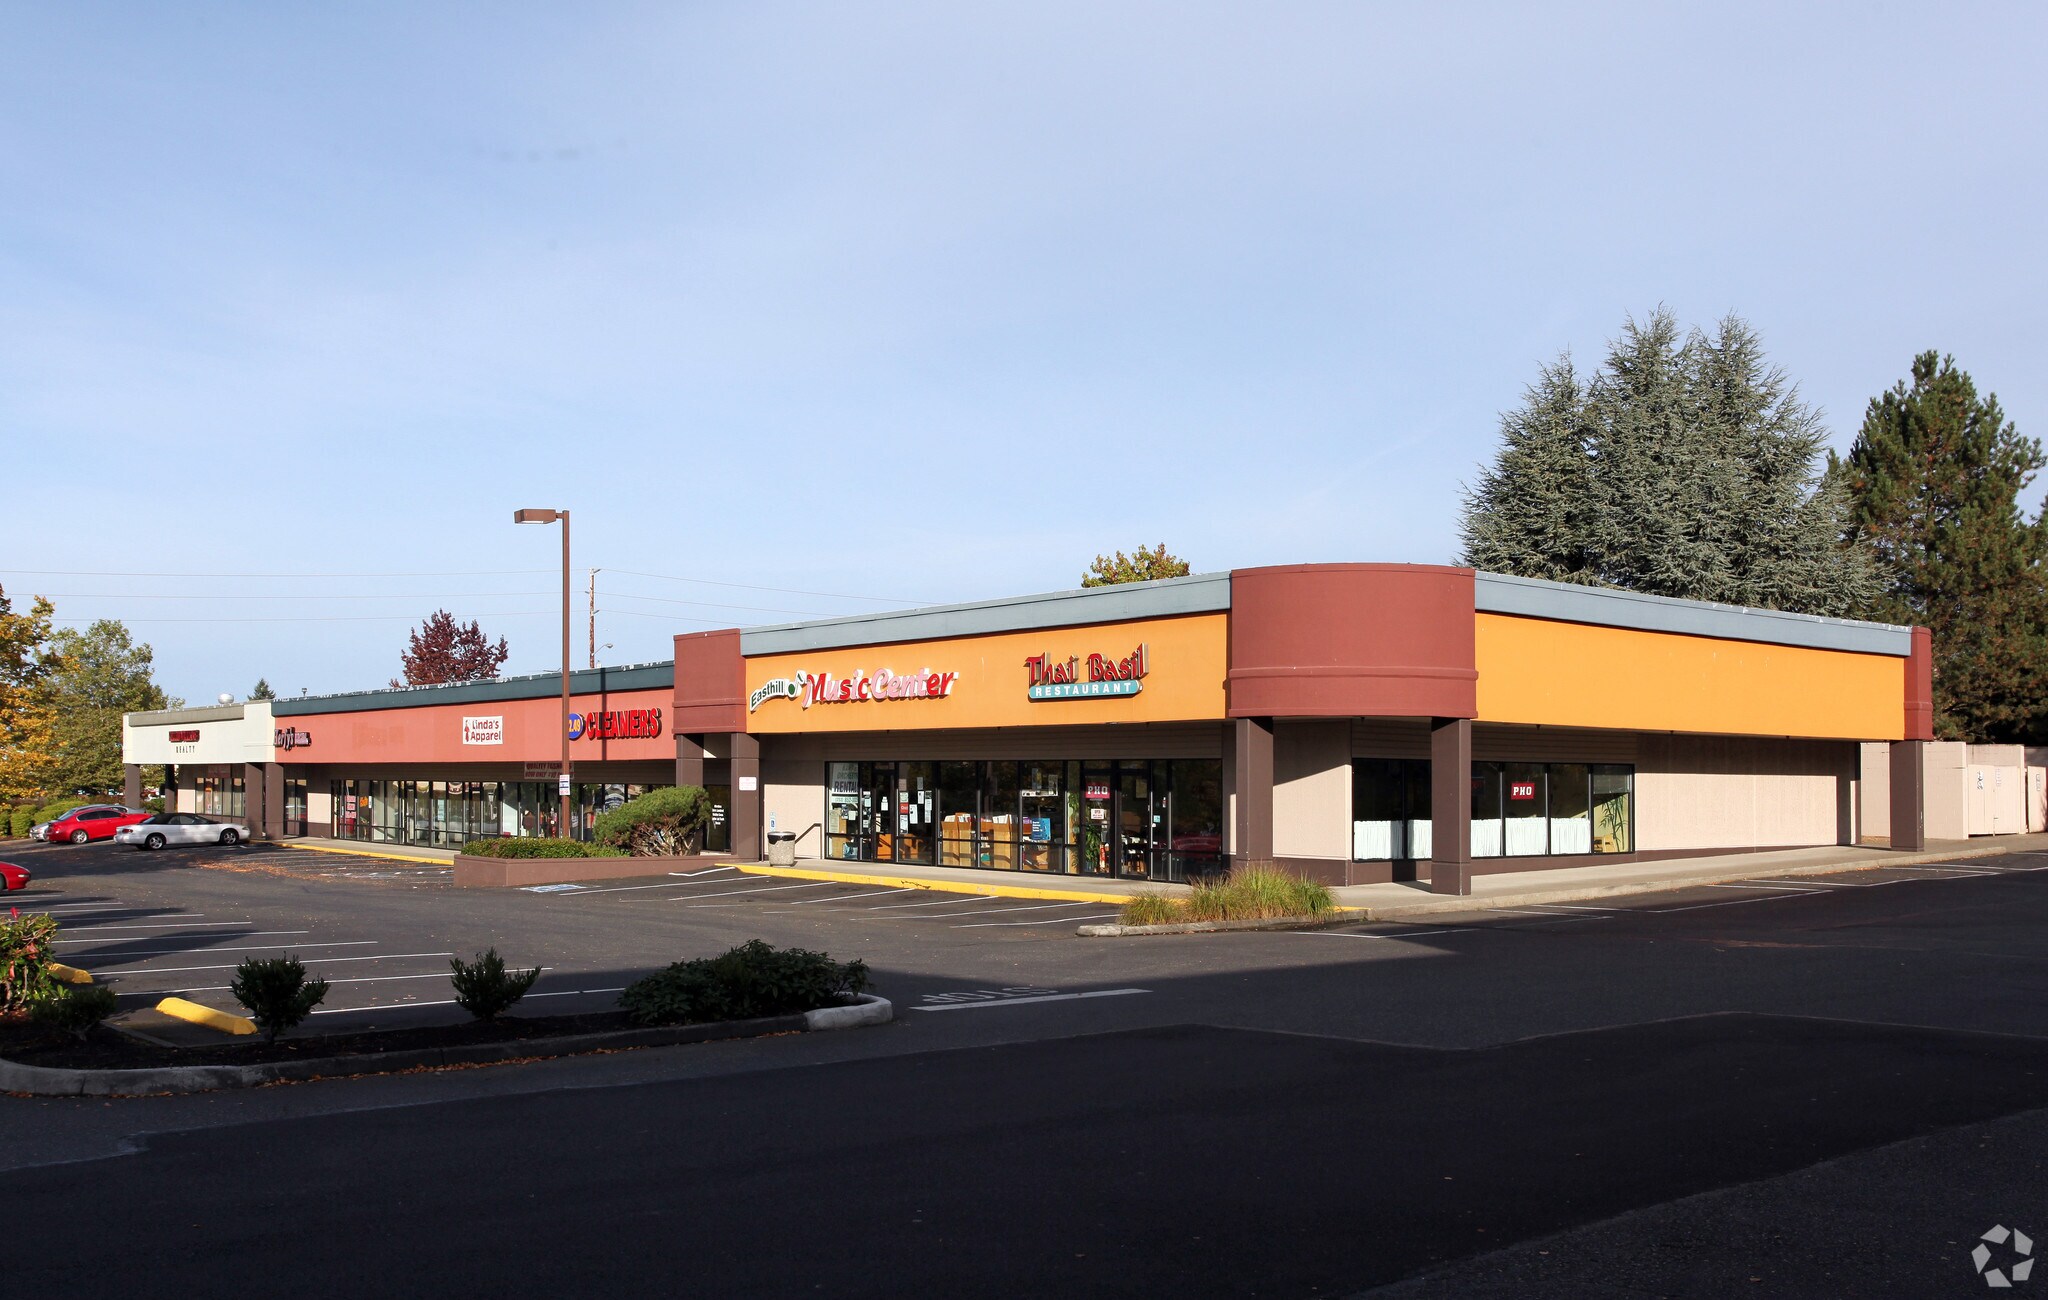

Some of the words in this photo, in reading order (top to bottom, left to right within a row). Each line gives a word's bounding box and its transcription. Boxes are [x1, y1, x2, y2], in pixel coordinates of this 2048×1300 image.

[1023, 651, 1079, 686] Thai
[1086, 642, 1149, 681] Basil
[751, 680, 784, 708] Easthill
[801, 669, 871, 708] Music
[871, 667, 957, 699] Center
[1035, 682, 1132, 697] RESTAURANT
[472, 719, 500, 730] Linda's
[586, 708, 662, 740] CLEANERS
[470, 730, 502, 743] Apparel
[176, 745, 195, 754] REALTY
[1087, 785, 1109, 795] PHO
[1512, 786, 1533, 796] PHO
